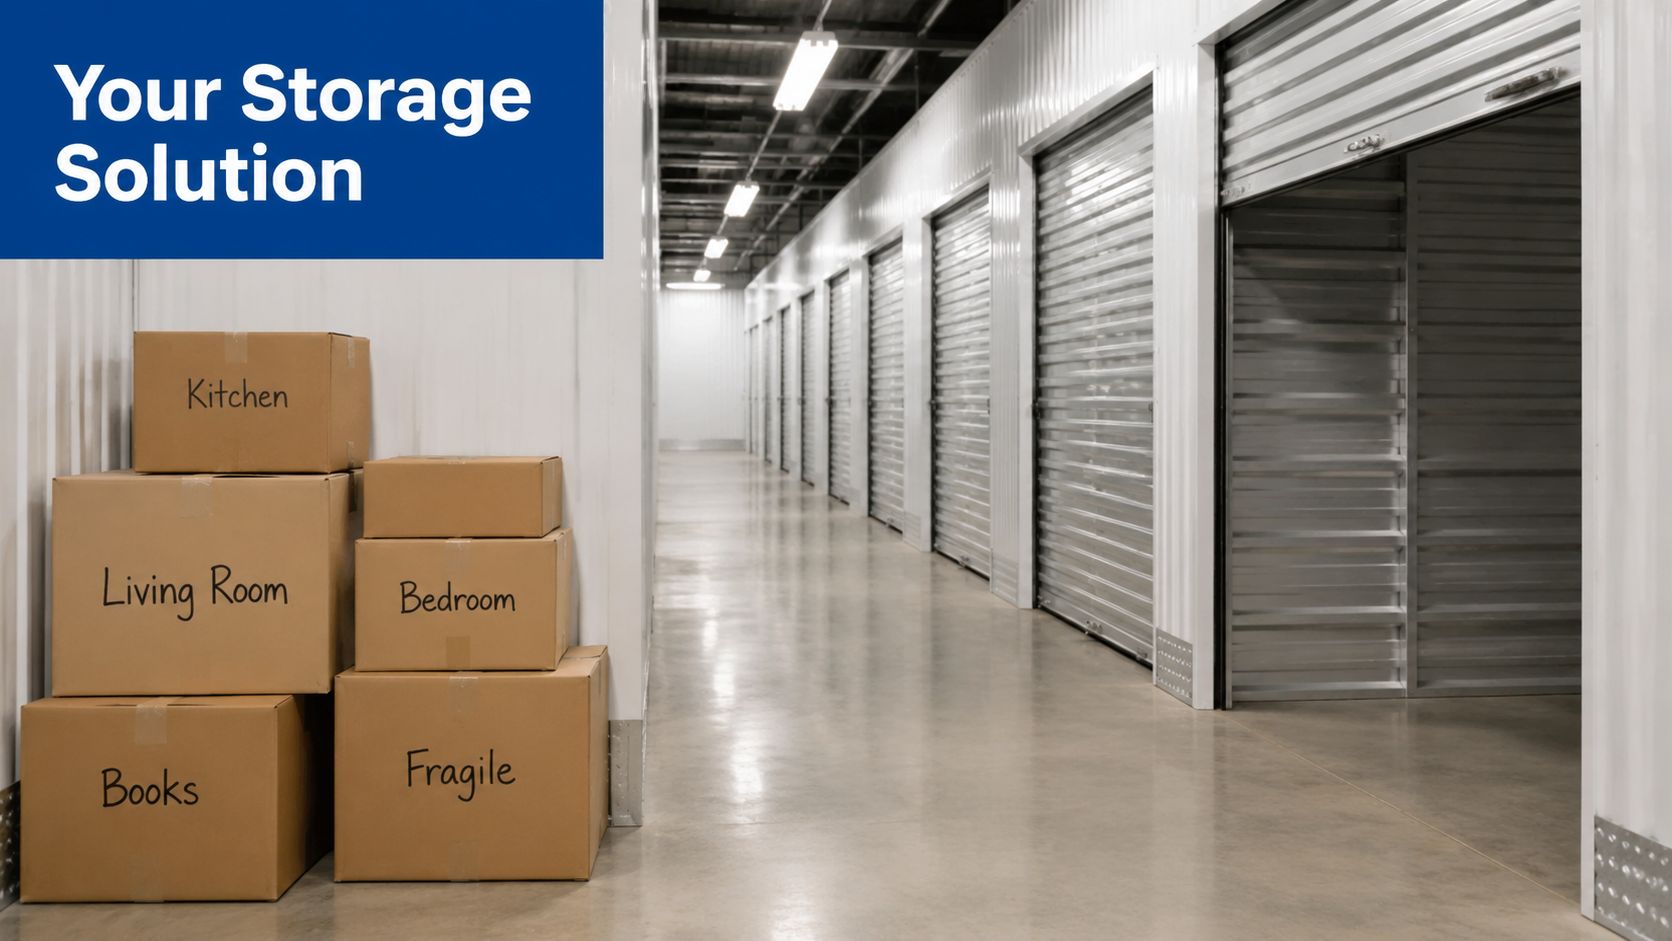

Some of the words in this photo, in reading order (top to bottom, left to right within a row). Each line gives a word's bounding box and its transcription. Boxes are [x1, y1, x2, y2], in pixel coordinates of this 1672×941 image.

[188, 378, 288, 410] Kitchen
[103, 566, 194, 621] Living
[211, 565, 288, 605] Room
[400, 580, 516, 614] Bedroom
[101, 768, 199, 808] Books
[407, 748, 516, 802] Fragile
